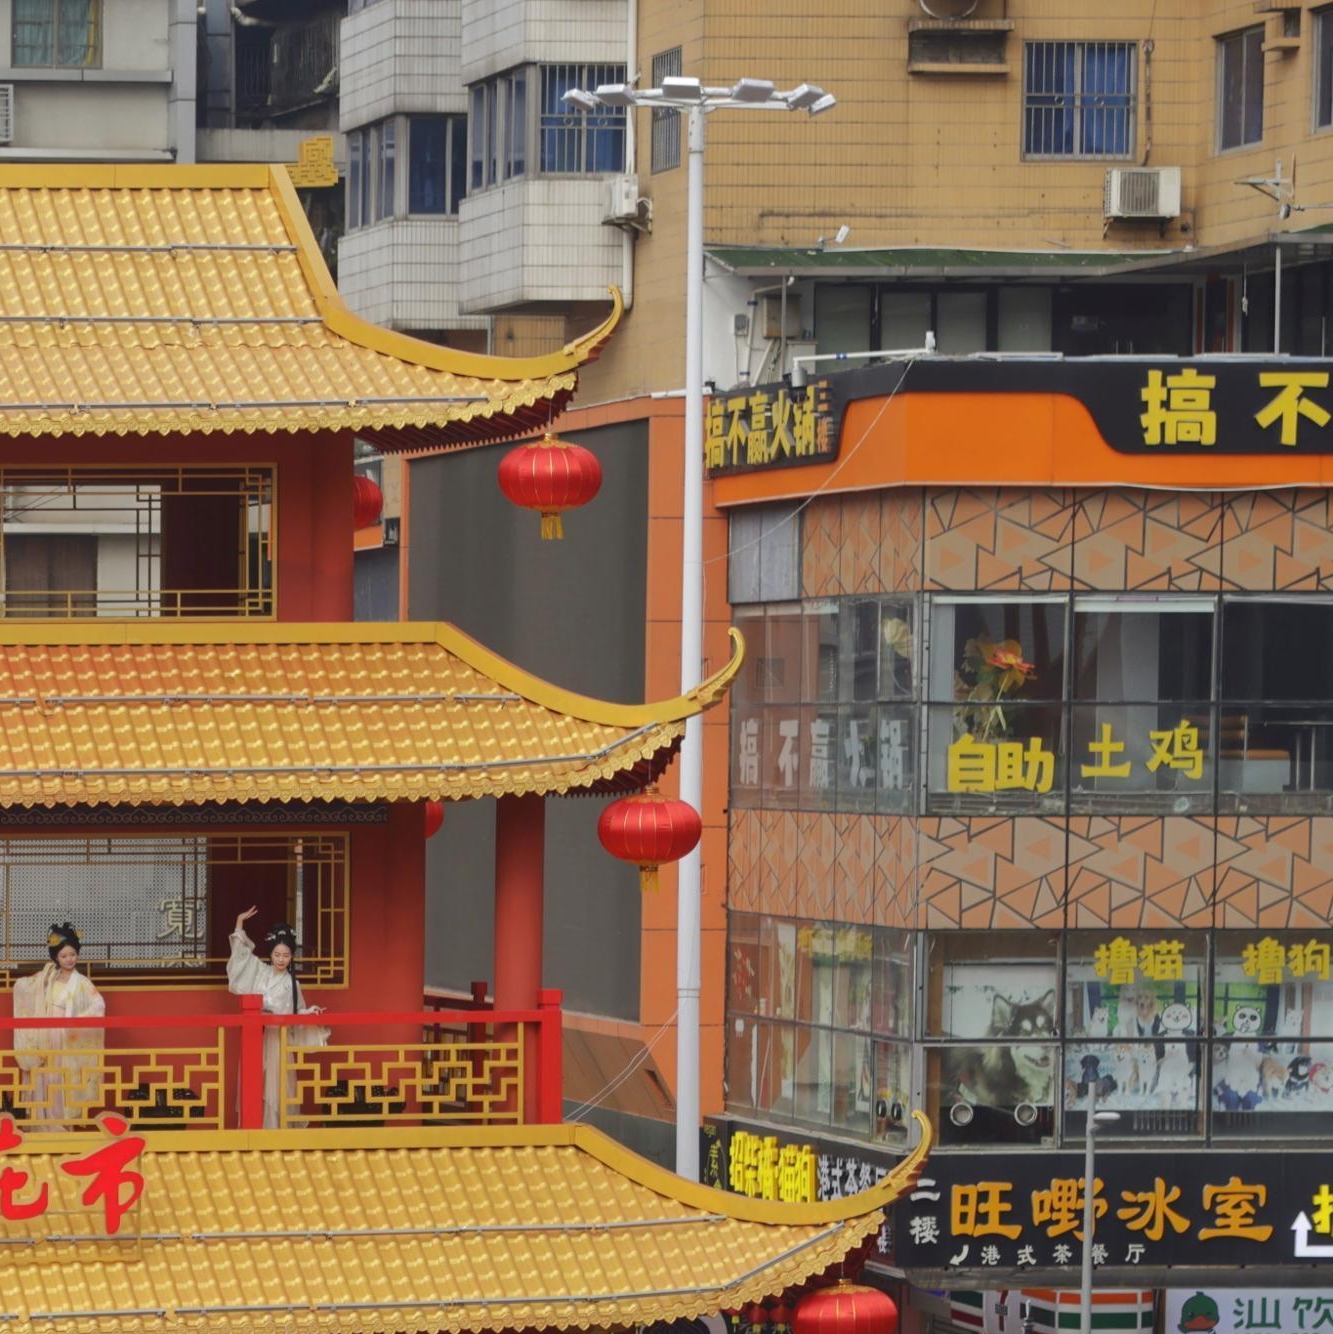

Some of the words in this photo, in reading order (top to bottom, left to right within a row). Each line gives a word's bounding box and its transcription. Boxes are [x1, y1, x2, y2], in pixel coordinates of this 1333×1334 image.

[705, 385, 815, 469] 搞不赢火锅
[948, 737, 1055, 793] 自助
[1081, 721, 1203, 780] 土鸡
[1094, 937, 1184, 985] 撸猫
[1242, 937, 1331, 985] 撸狗
[910, 1178, 940, 1245] 二楼
[950, 1176, 1274, 1242] 旺嘢冰室
[981, 1243, 1146, 1265] 港式茶餐厅
